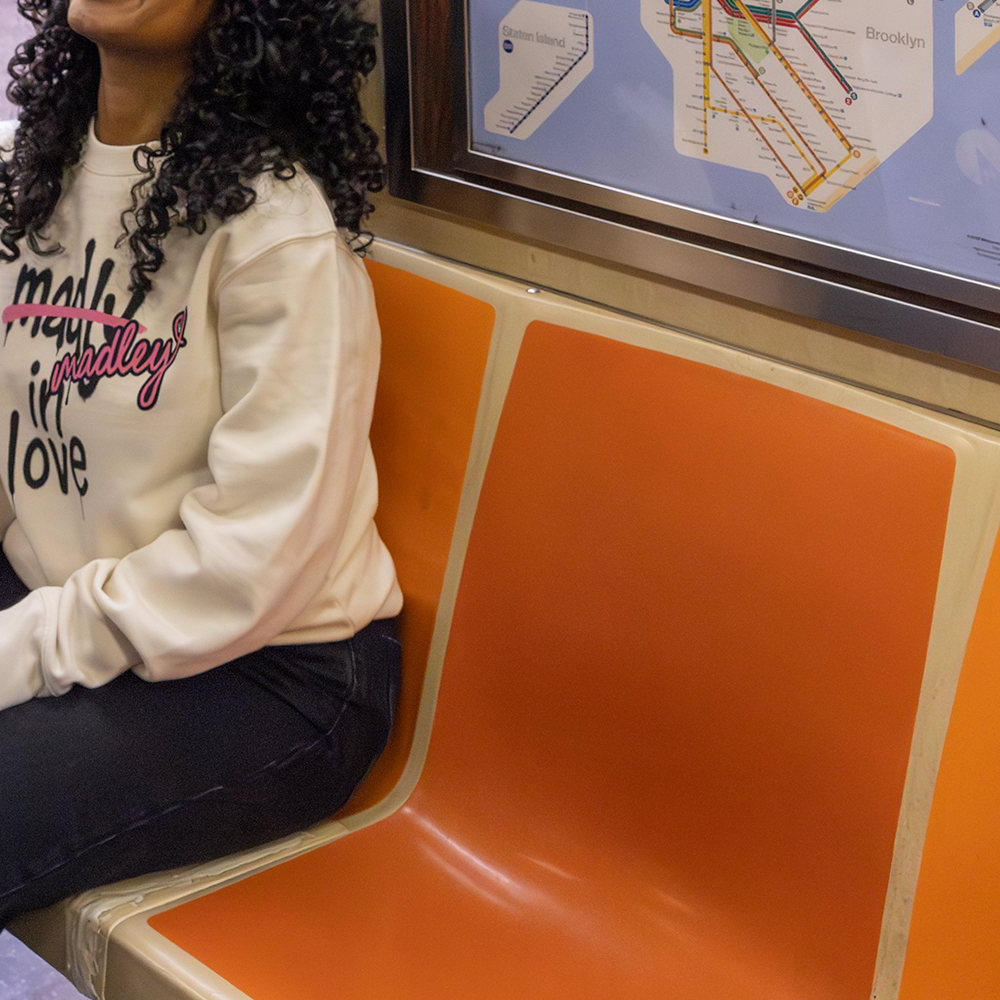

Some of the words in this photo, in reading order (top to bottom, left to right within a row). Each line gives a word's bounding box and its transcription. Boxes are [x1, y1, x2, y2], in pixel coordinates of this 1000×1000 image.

[502, 25, 534, 42] Staten
[536, 32, 566, 48] Island
[866, 26, 926, 49] Brooklyn
[49, 305, 187, 410] madley
[6, 410, 90, 501] love
